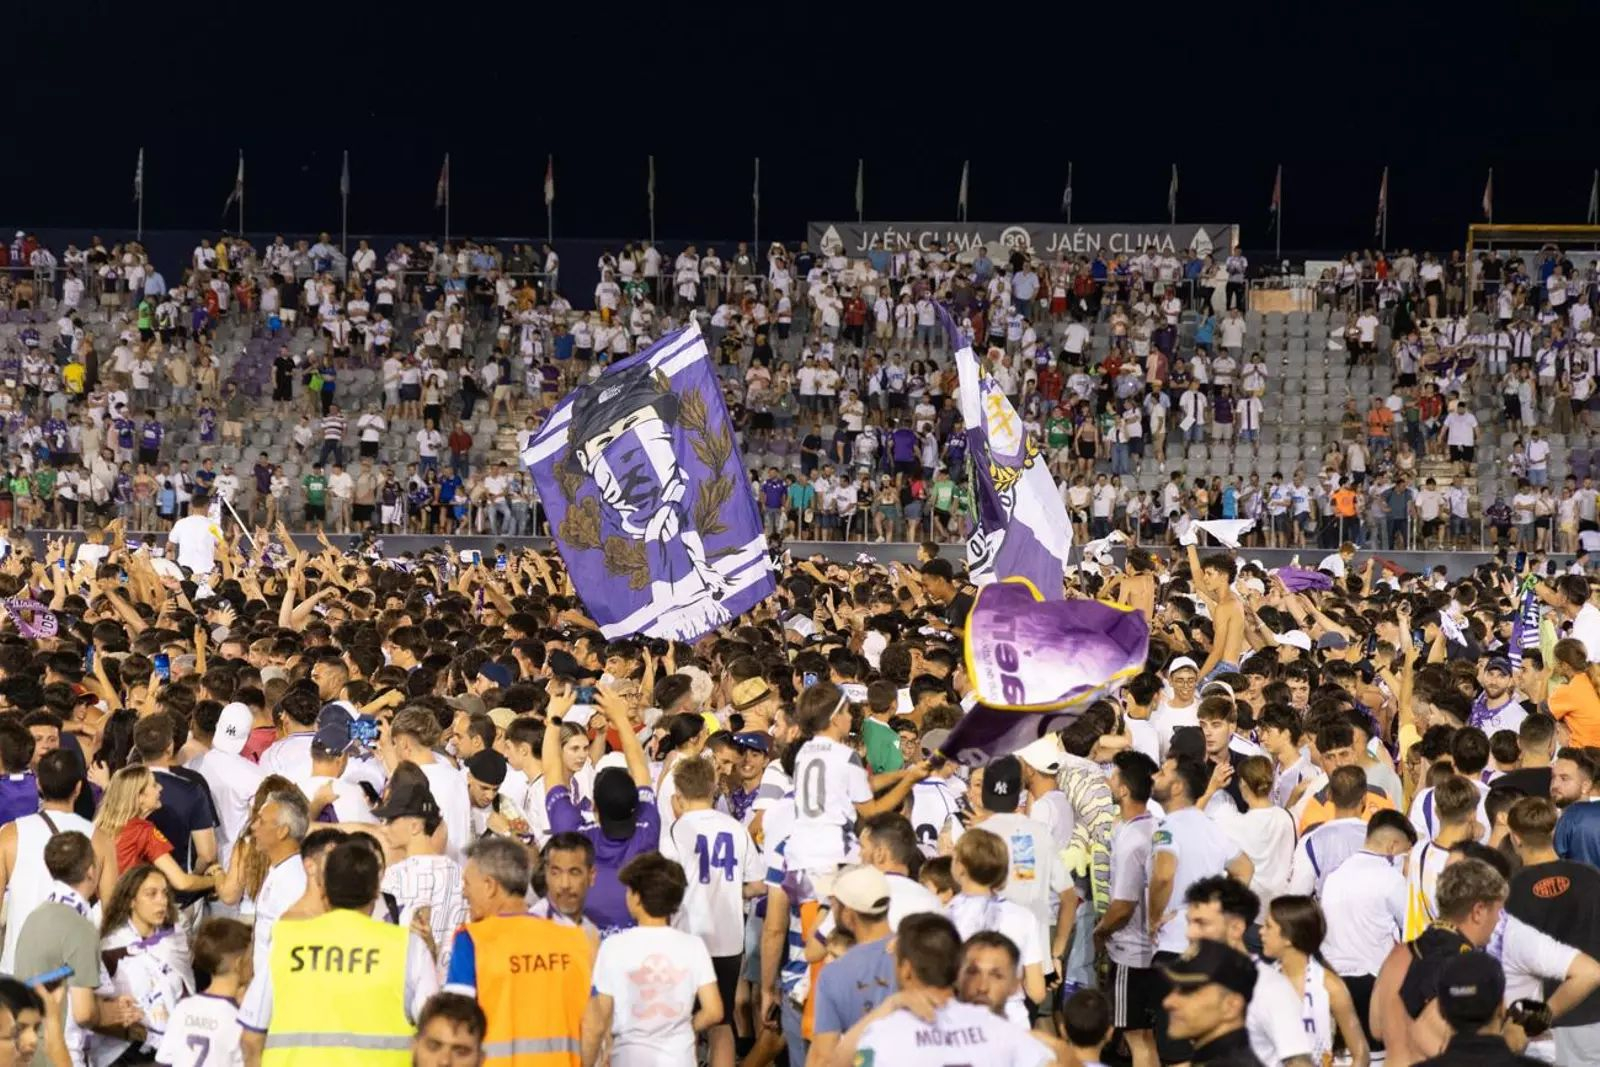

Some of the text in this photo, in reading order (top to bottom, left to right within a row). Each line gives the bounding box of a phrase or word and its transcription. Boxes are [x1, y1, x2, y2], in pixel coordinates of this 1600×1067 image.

[856, 226, 911, 251] JAÉN
[1045, 227, 1176, 253] JAÉN CLIMA
[694, 831, 738, 884] 14
[290, 945, 381, 974] STAFF
[509, 952, 571, 974] STAFF
[186, 1034, 210, 1067] 7
